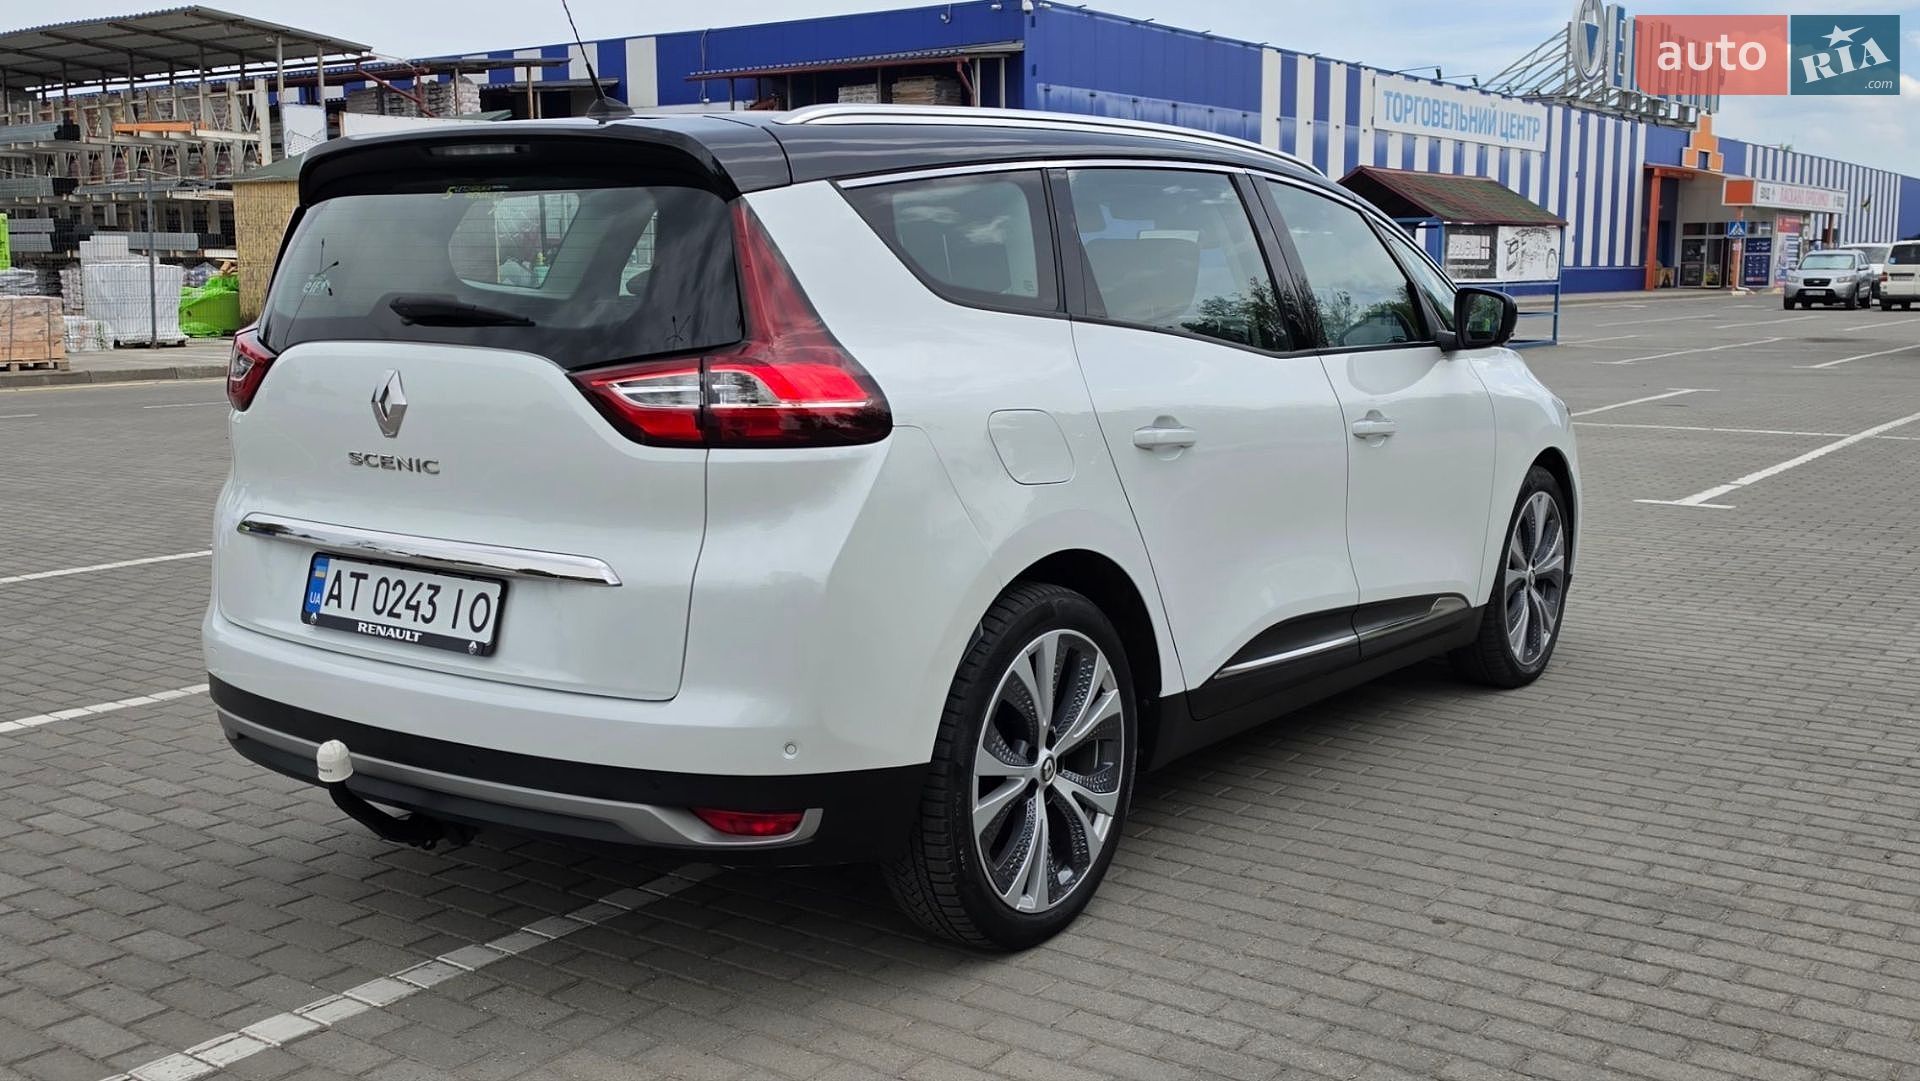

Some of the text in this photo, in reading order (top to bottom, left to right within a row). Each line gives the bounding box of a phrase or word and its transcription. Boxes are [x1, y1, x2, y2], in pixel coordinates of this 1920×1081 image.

[1383, 91, 1541, 143] ТОРГОВЕЛЬНИЙ ЦЕНТР
[348, 451, 441, 475] SCENIC
[309, 591, 321, 605] UA
[324, 569, 369, 611] AT
[372, 576, 442, 625] 0243
[357, 621, 423, 642] RENAULT
